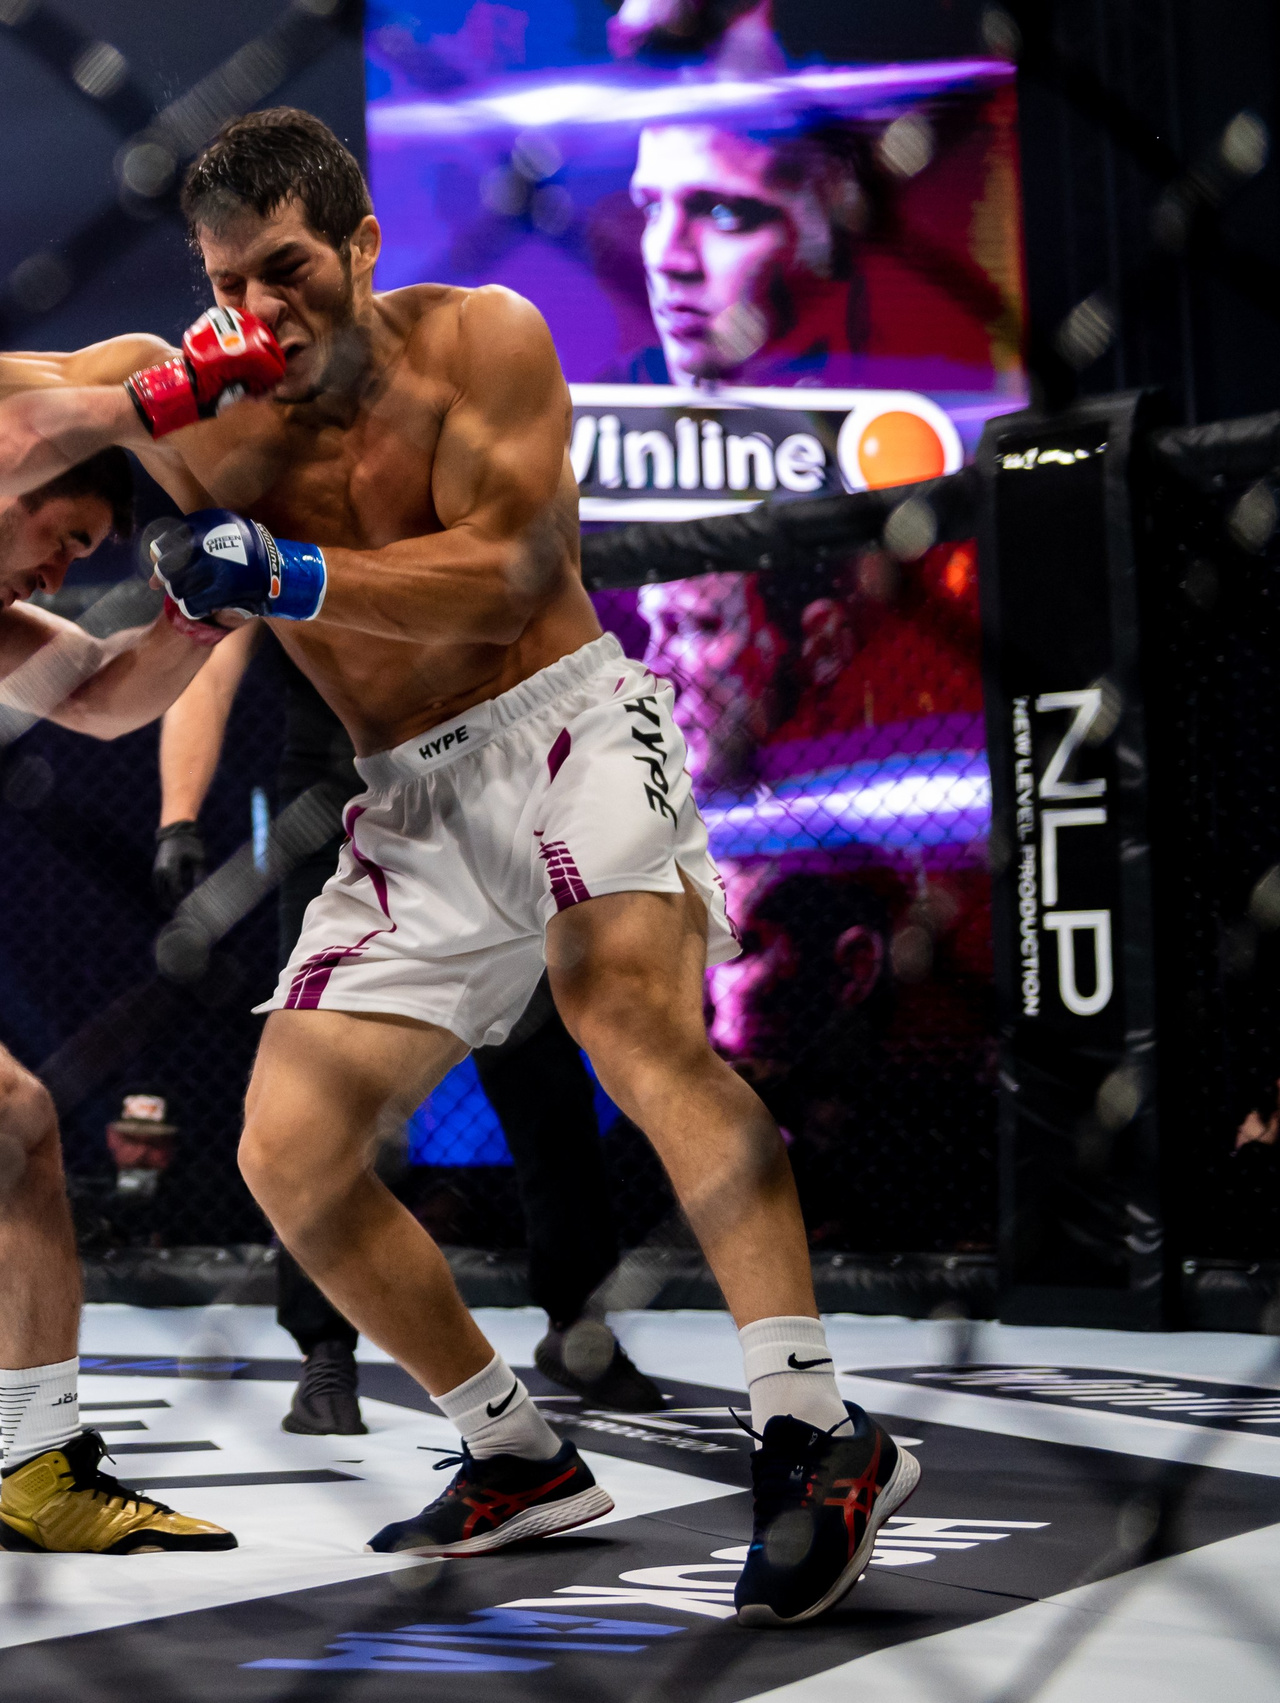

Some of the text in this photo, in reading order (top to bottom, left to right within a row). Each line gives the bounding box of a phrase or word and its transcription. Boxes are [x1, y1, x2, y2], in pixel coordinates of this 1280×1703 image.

[206, 535, 241, 546] GREEN
[208, 541, 239, 553] HILL
[419, 725, 470, 760] HYPE
[622, 696, 678, 831] HYPE
[1015, 758, 1035, 842] LEVEL
[1035, 688, 1114, 1017] NLP
[1018, 844, 1041, 1017] PRODUCTION
